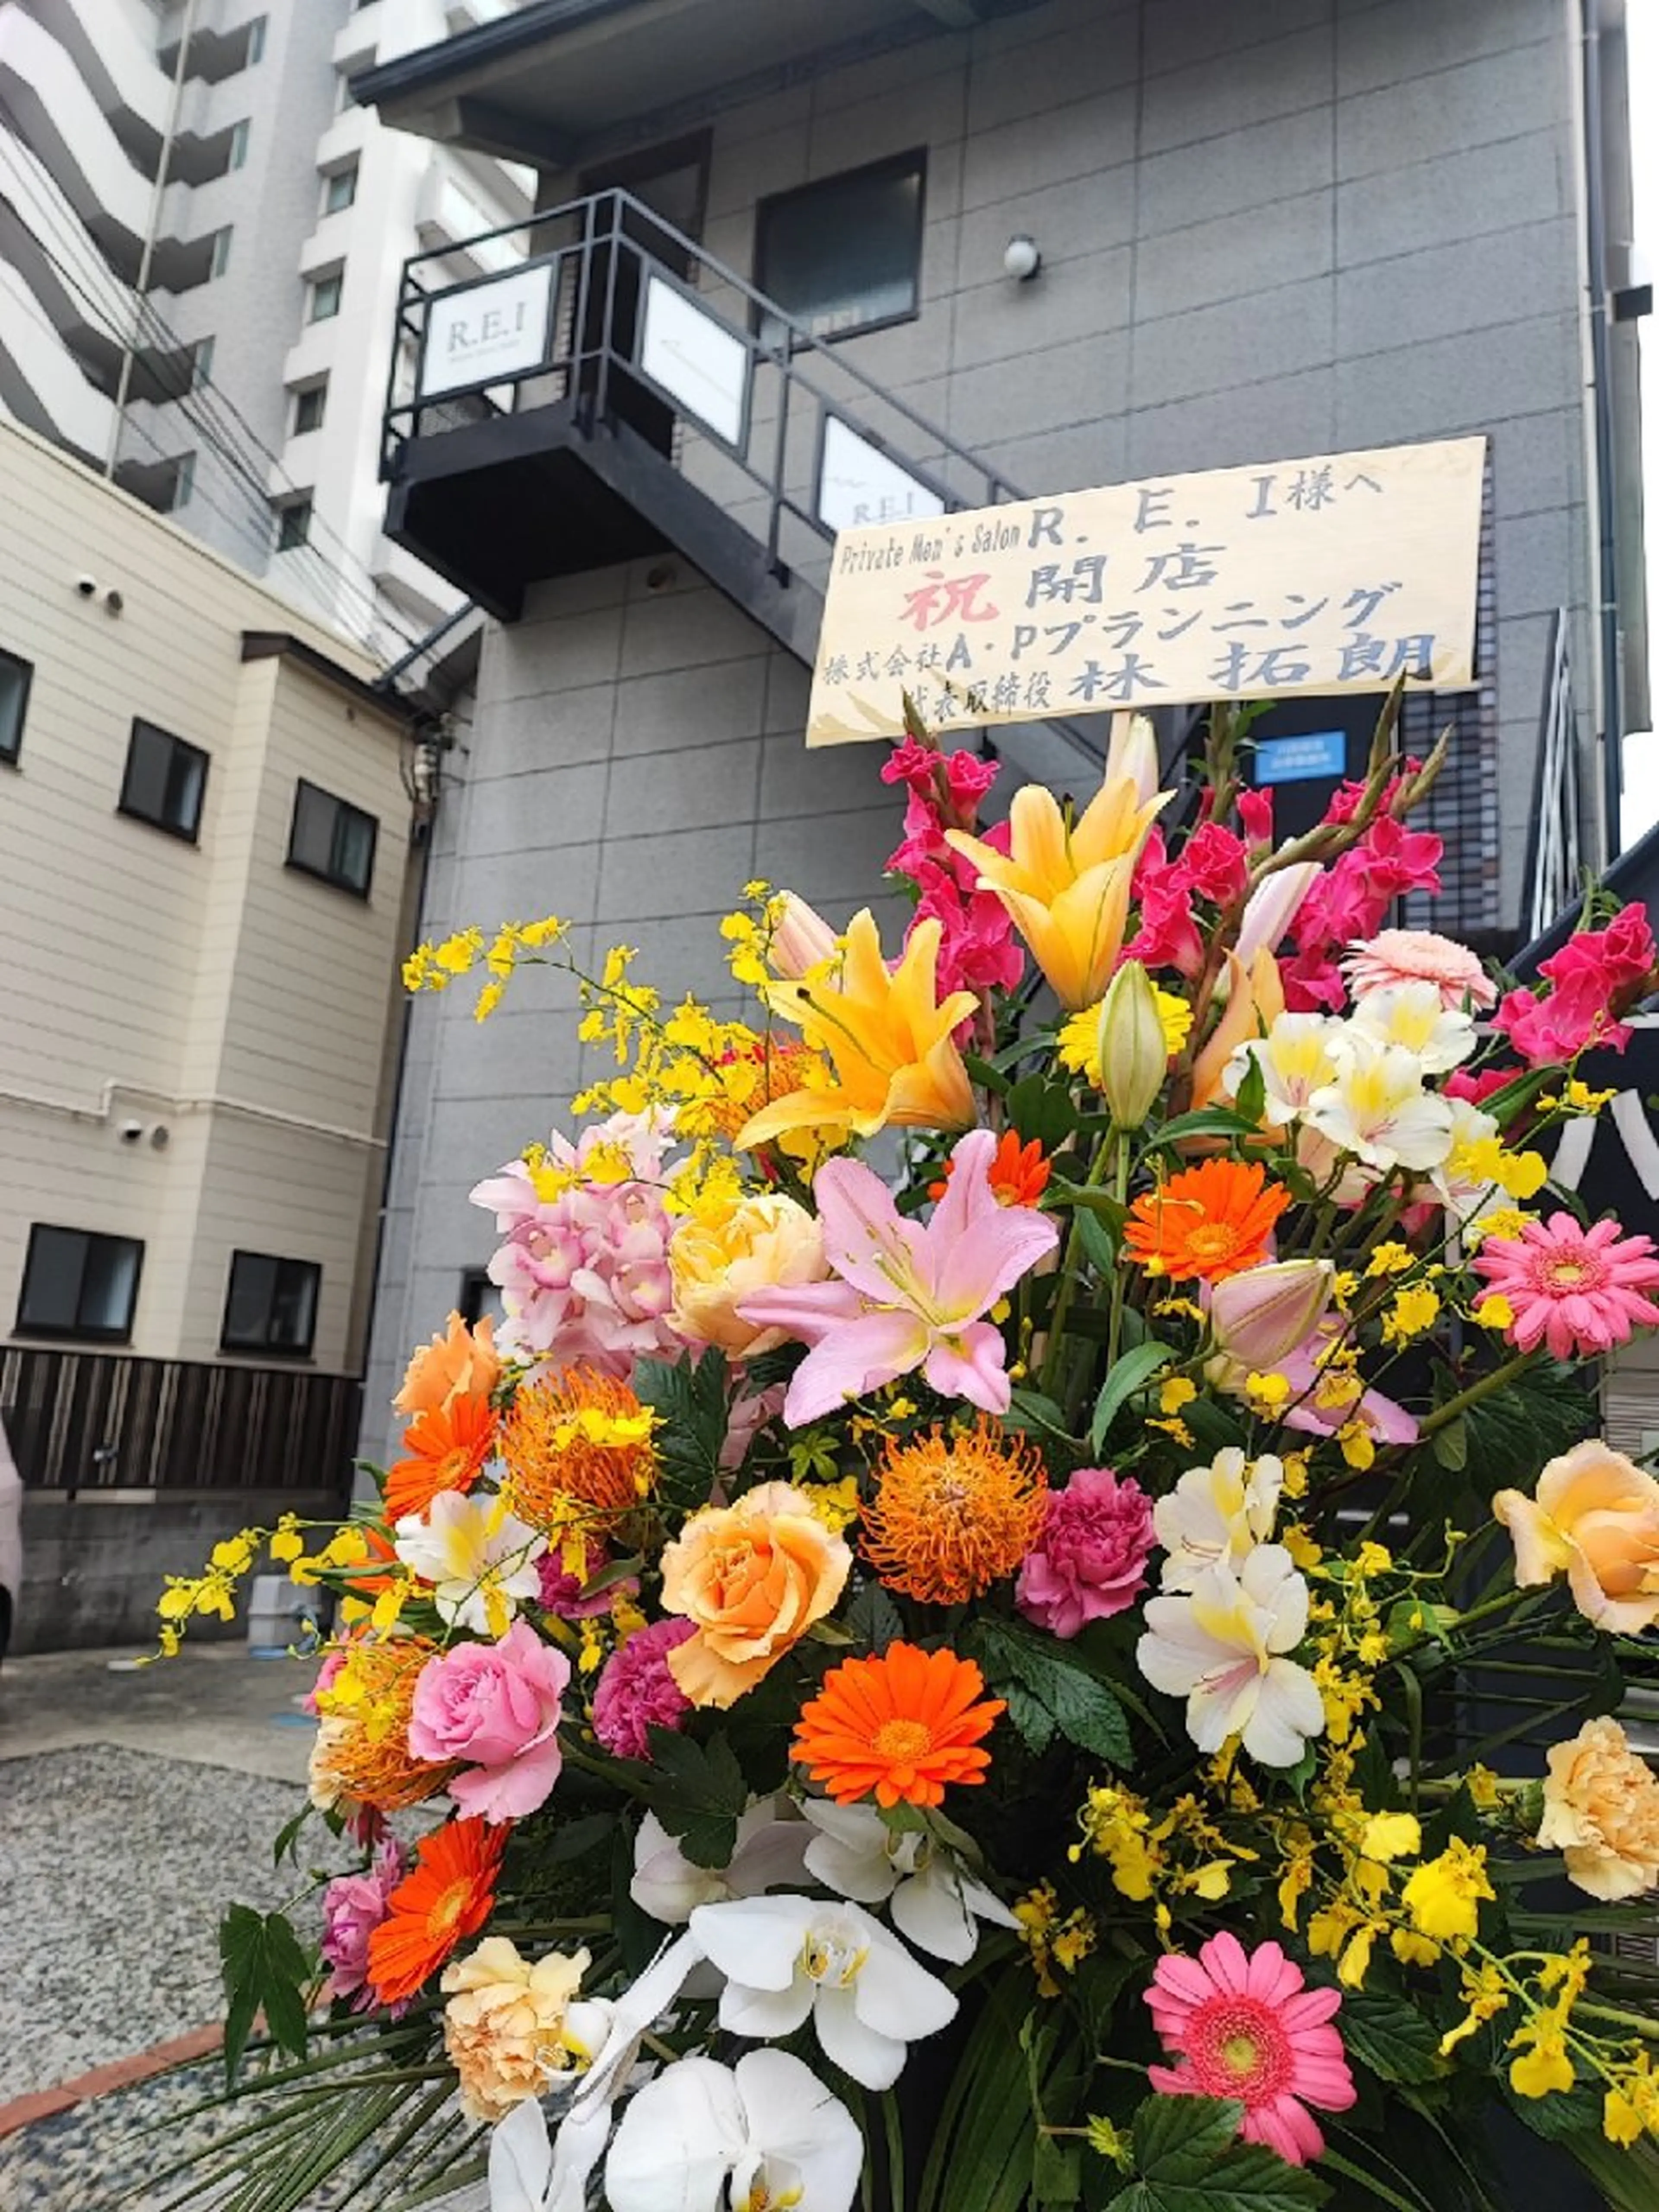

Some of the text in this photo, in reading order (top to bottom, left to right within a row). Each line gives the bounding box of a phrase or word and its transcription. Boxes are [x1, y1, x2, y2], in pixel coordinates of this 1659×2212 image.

[448, 302, 526, 352] R.E.I
[839, 537, 904, 575] Private
[971, 520, 1020, 554] Salon
[898, 571, 1000, 631] 祝
